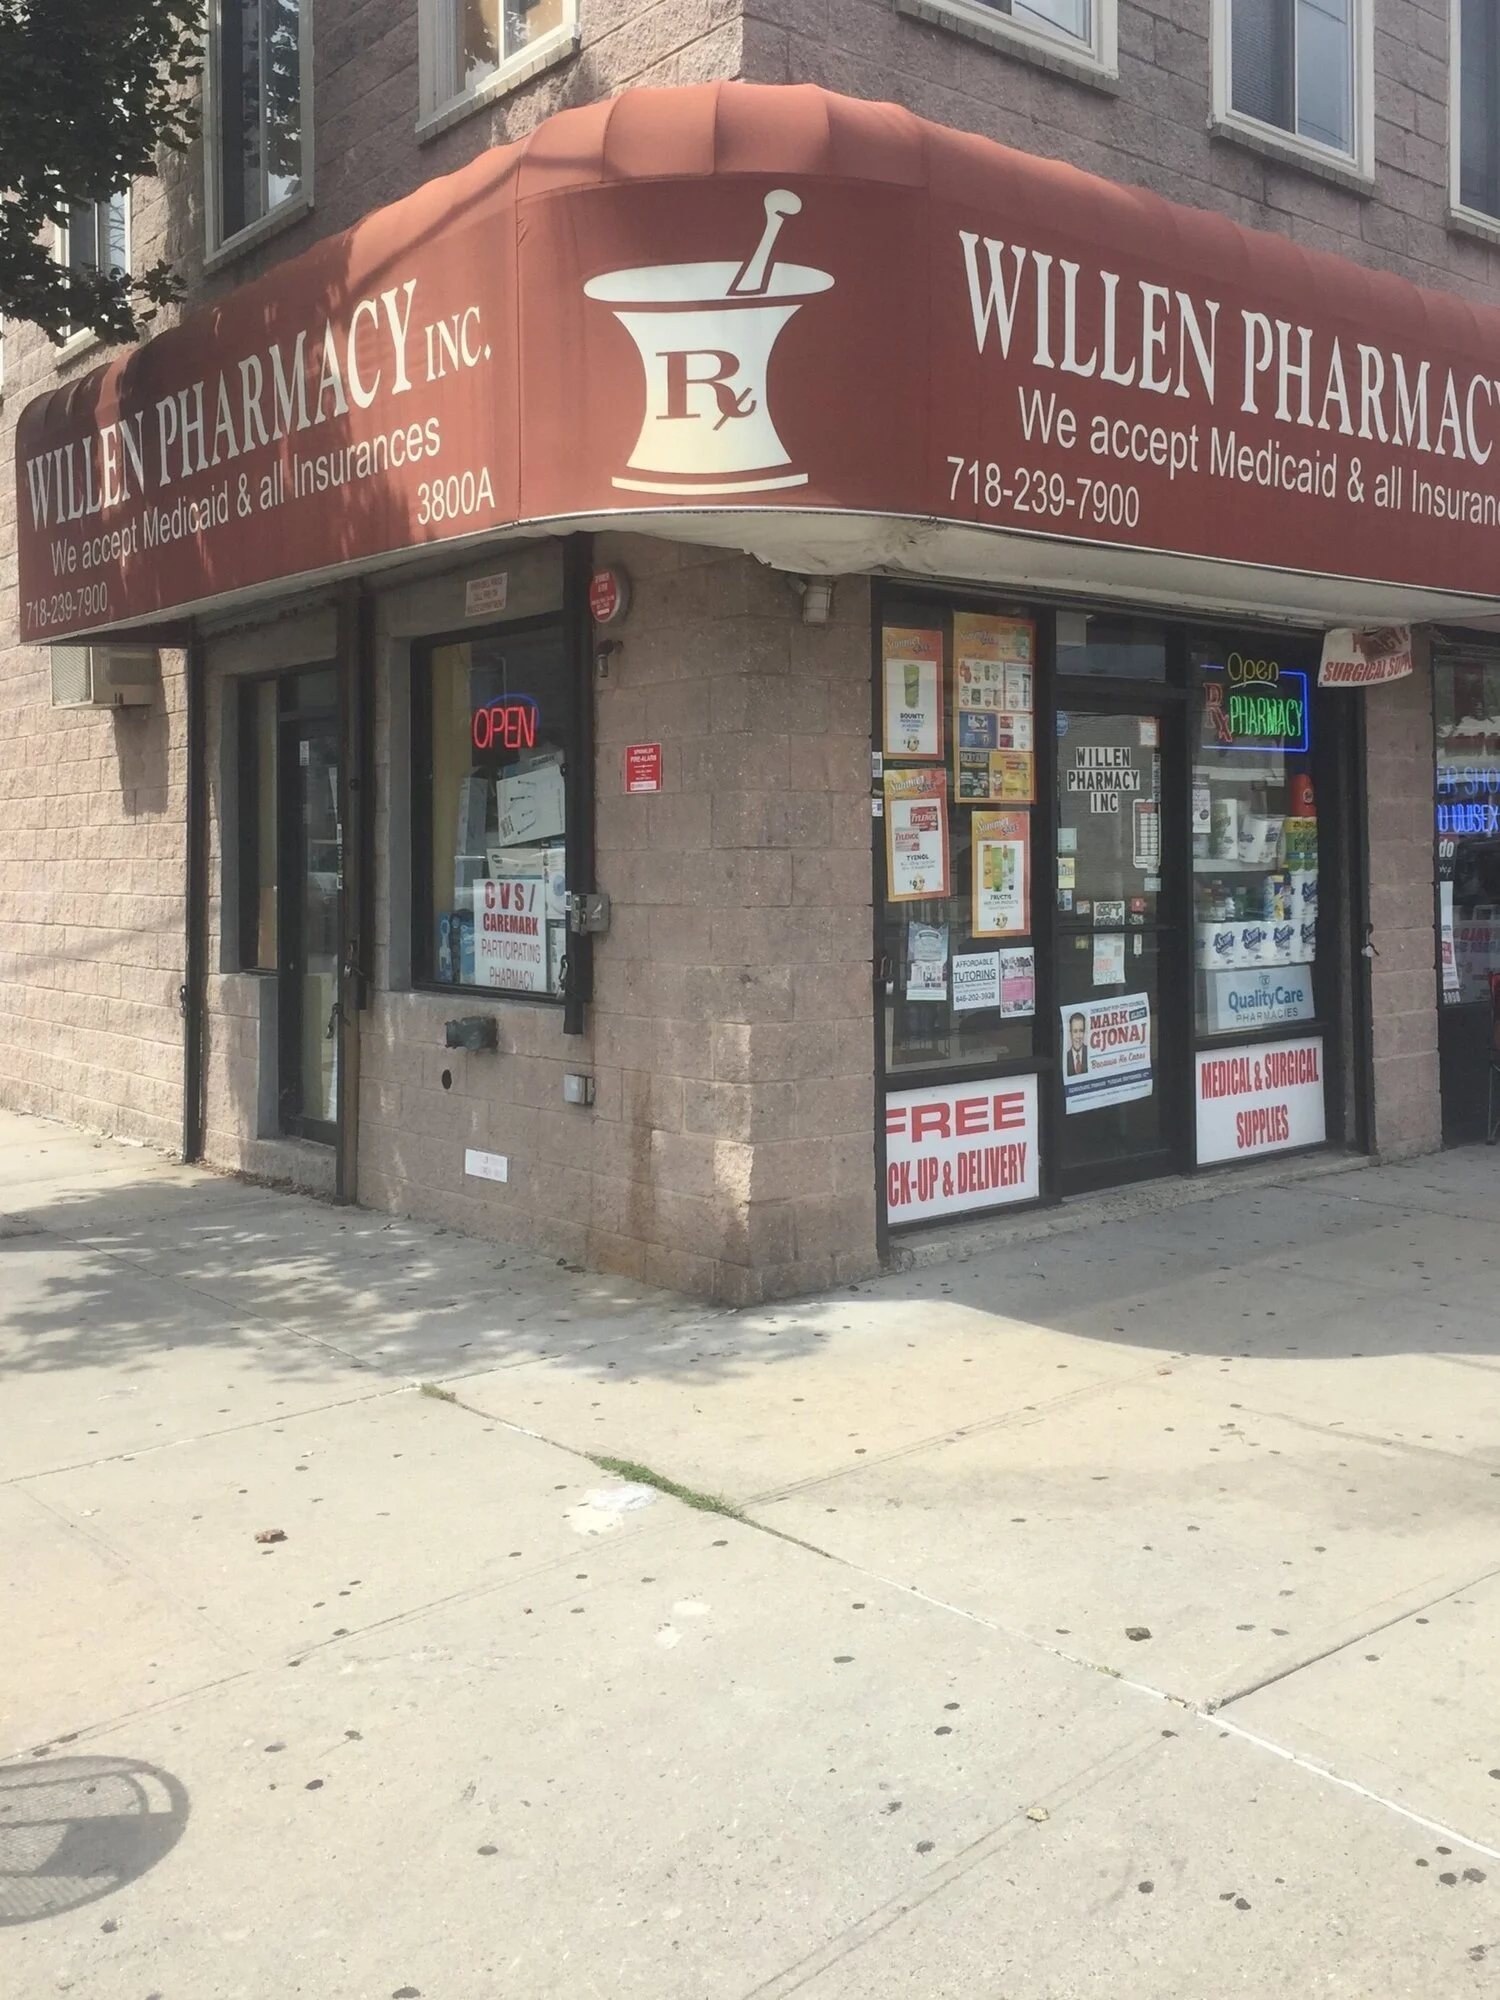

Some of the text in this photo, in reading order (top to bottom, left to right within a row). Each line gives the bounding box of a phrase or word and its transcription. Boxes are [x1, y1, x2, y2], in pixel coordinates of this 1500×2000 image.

[958, 229, 1220, 406] WILLEN
[26, 278, 492, 532] WILLEN PHARMACY INC.
[1018, 385, 1500, 527] We accept Medicaid & all Insuran
[50, 417, 441, 577] We accept Medicaid & all Insurances
[417, 466, 496, 525] 3800A
[947, 455, 1140, 529] 718-239-7900
[26, 581, 108, 629] 718-239-7900
[1227, 652, 1279, 687] Open
[1323, 660, 1386, 682] SURGICAL
[473, 706, 537, 748] OPEN
[1229, 695, 1303, 736] PHARMACY
[1076, 747, 1131, 767] WILLEN
[1067, 770, 1139, 790] PHARMACY
[1093, 793, 1118, 812] INC
[482, 913, 540, 937] CAREMARK
[481, 938, 541, 964] PARTICIPATING
[489, 966, 535, 991] PHARMACY
[953, 968, 997, 982] TUTORING
[1089, 1010, 1128, 1030] MARK
[1235, 1007, 1299, 1023] PHARMACIES
[1089, 1022, 1147, 1051] GJONAJ
[1200, 1047, 1319, 1100] MEDICAL & SURGICAL
[886, 1091, 1026, 1144] FREE
[1236, 1104, 1290, 1149] SUPPLIES
[942, 1160, 955, 1198] &
[957, 1142, 1027, 1194] DELIVERY
